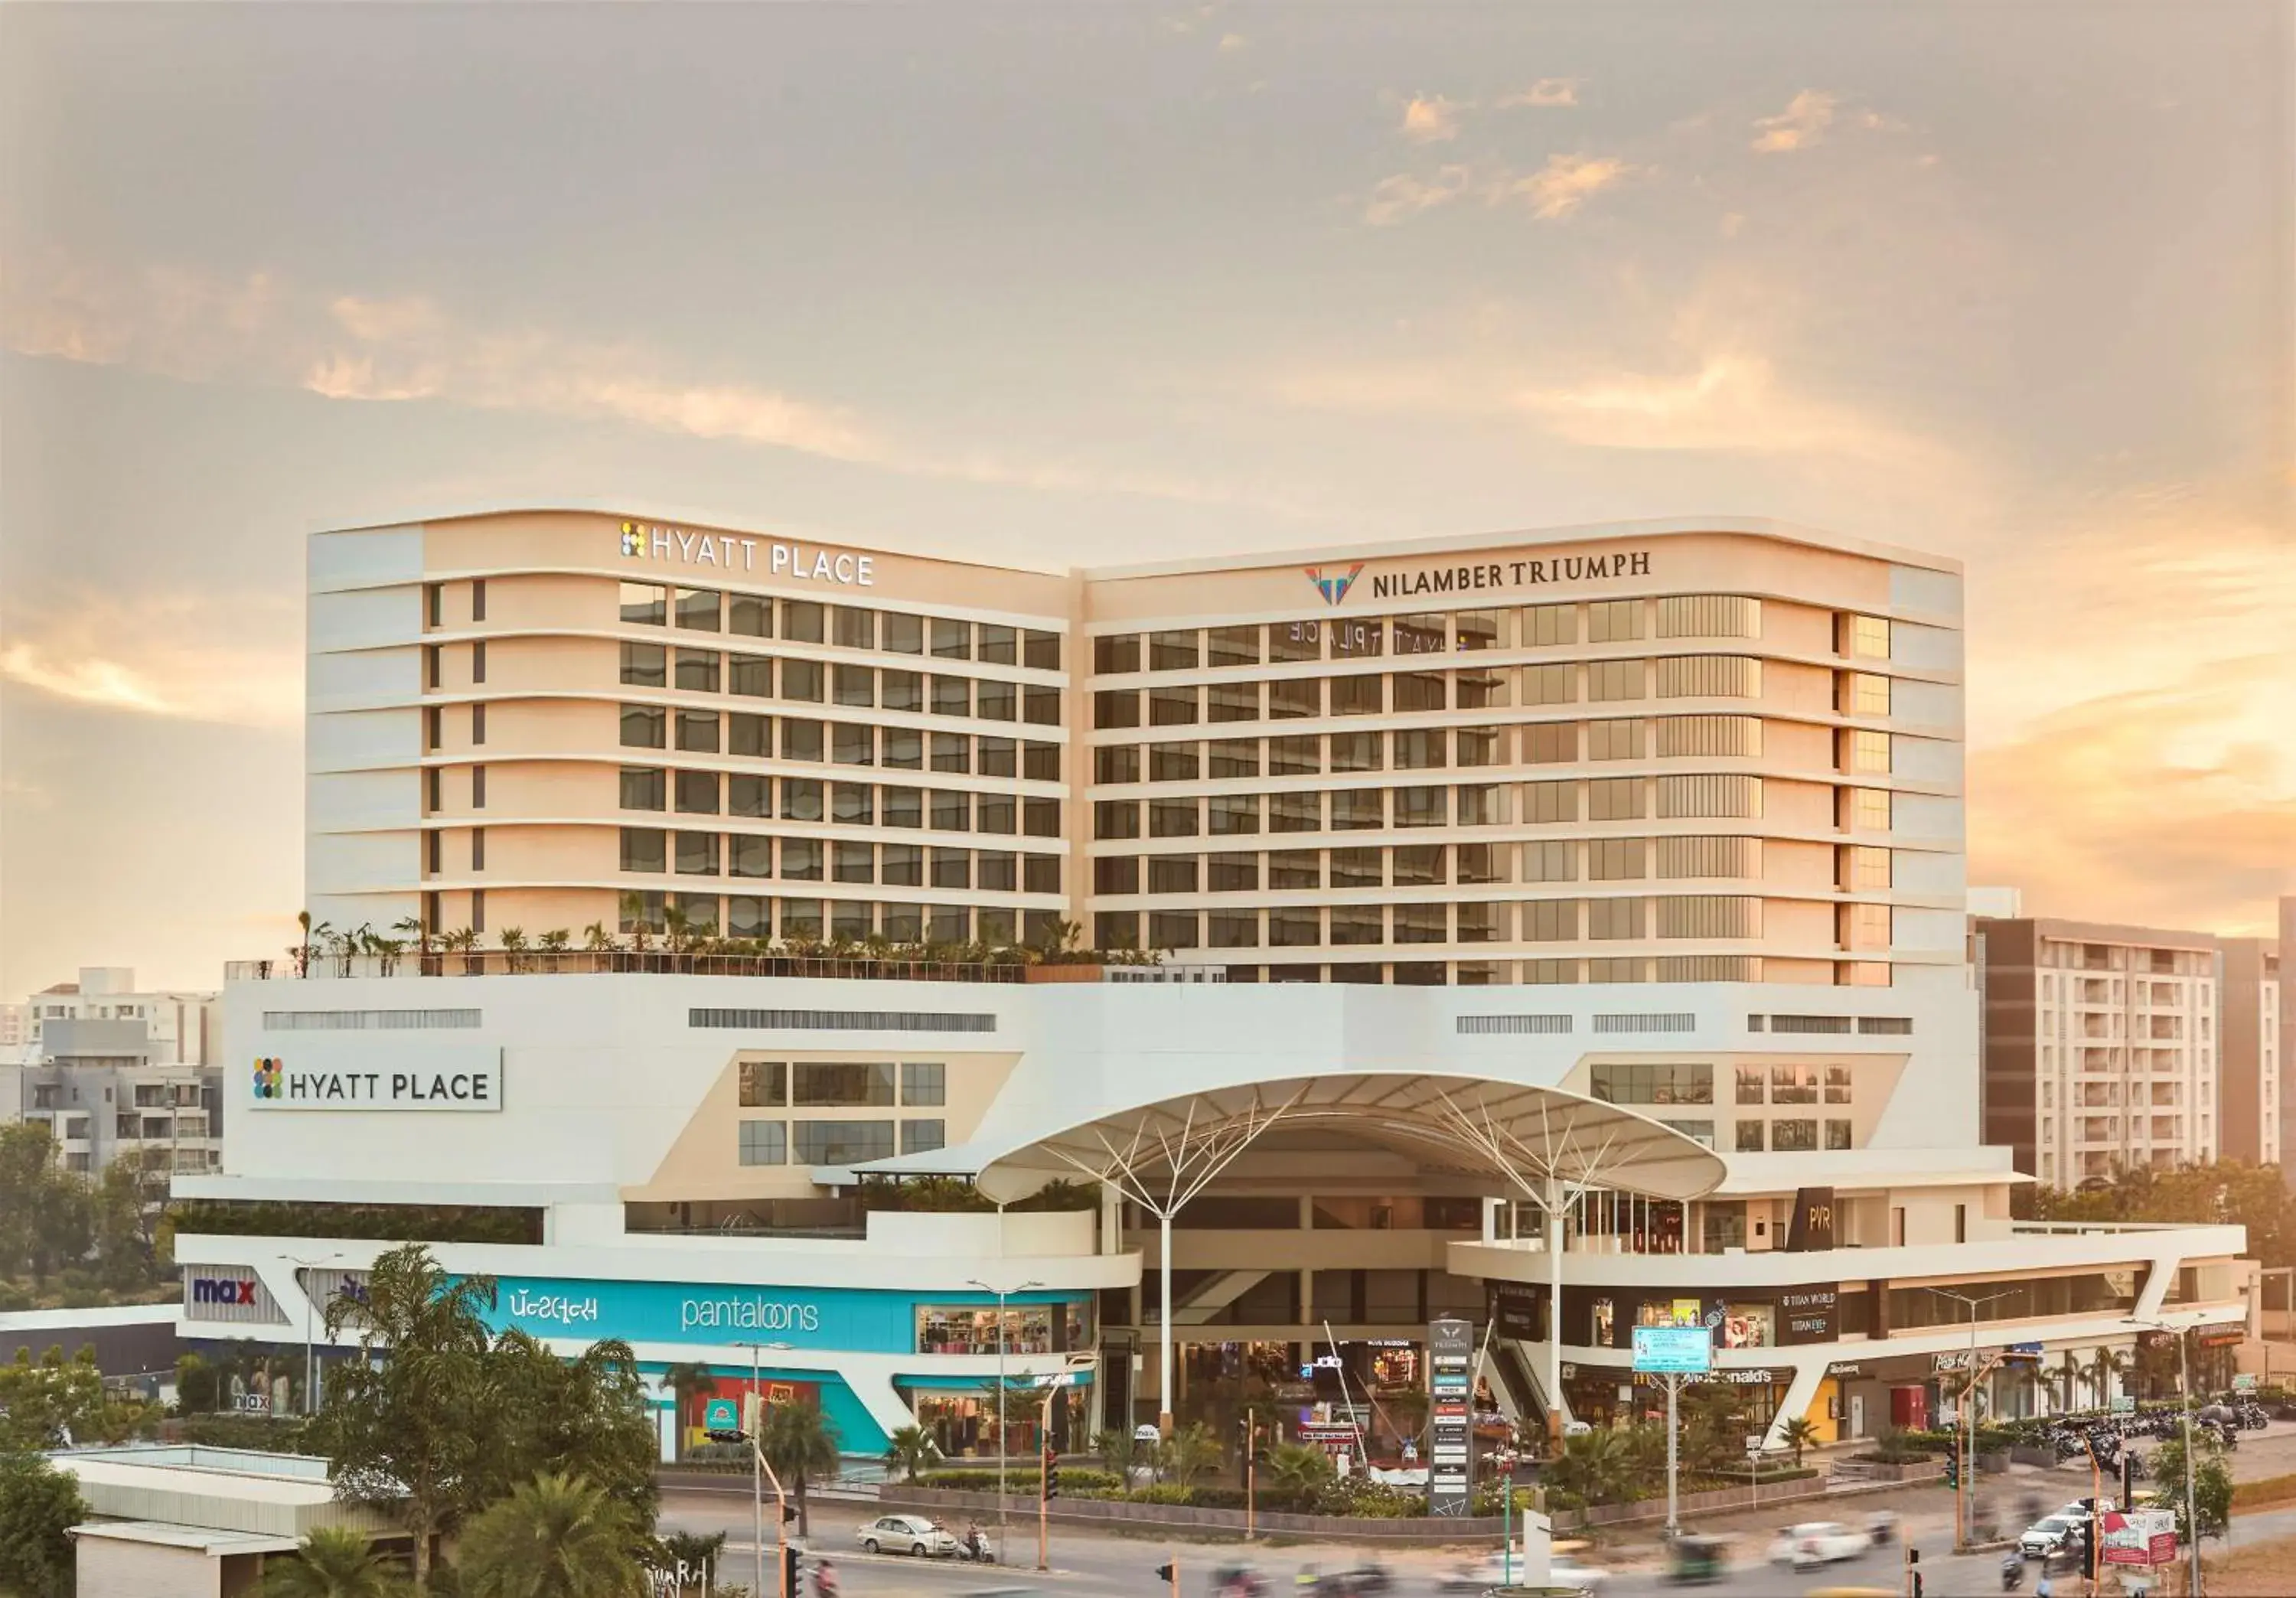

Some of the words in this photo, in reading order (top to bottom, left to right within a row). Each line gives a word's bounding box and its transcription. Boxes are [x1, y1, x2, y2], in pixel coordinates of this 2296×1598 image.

[651, 527, 755, 571] HYATT
[771, 543, 874, 586] PLACE
[1373, 565, 1502, 598] NILAMBER
[1509, 552, 1652, 585] TRIUMPH
[290, 1074, 380, 1100] HYATT
[392, 1074, 488, 1100] PLACE
[1810, 1205, 1831, 1231] PVR
[193, 1277, 256, 1306] max
[1790, 1294, 1809, 1306] TITAN
[1810, 1292, 1836, 1306] WORLD
[681, 1294, 819, 1332] pantaloons
